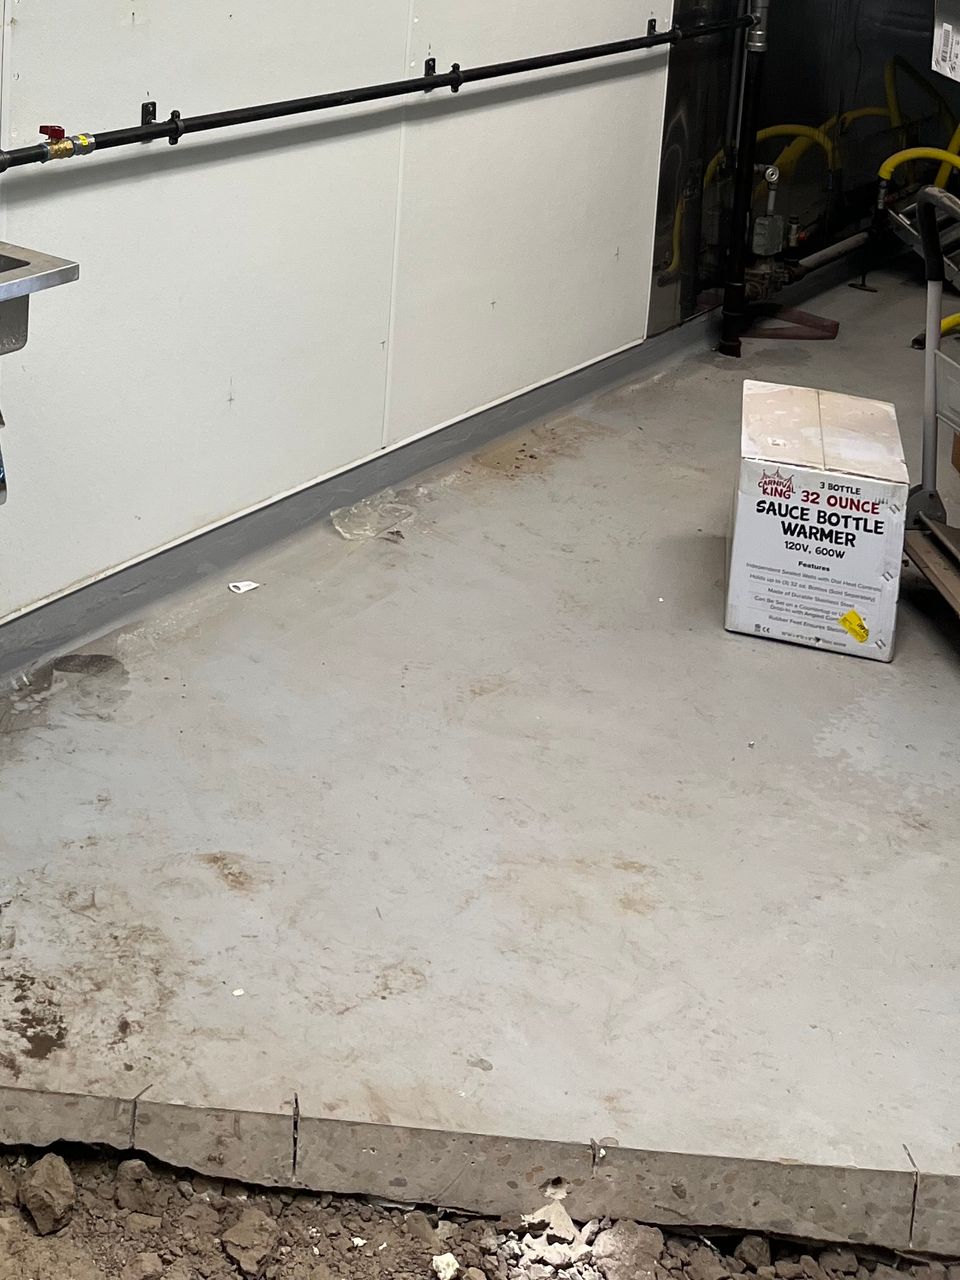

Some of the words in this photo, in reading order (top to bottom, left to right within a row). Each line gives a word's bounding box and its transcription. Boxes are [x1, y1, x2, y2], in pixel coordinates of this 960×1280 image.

[757, 477, 796, 494] CARNIVAL
[762, 484, 791, 500] KING
[819, 481, 826, 490] 3
[827, 482, 862, 496] BOTTLE
[800, 489, 821, 505] 32
[826, 494, 881, 515] OUNCE
[756, 499, 810, 522] SAUCE
[816, 509, 885, 535] BOTTLE
[781, 520, 857, 548] WARMER
[784, 540, 812, 554] 120V,
[815, 546, 846, 559] 600W
[798, 560, 831, 572] Features
[749, 573, 766, 581] Holds
[767, 587, 784, 595] Made
[791, 591, 814, 601] Durable
[803, 620, 826, 631] Ensures
